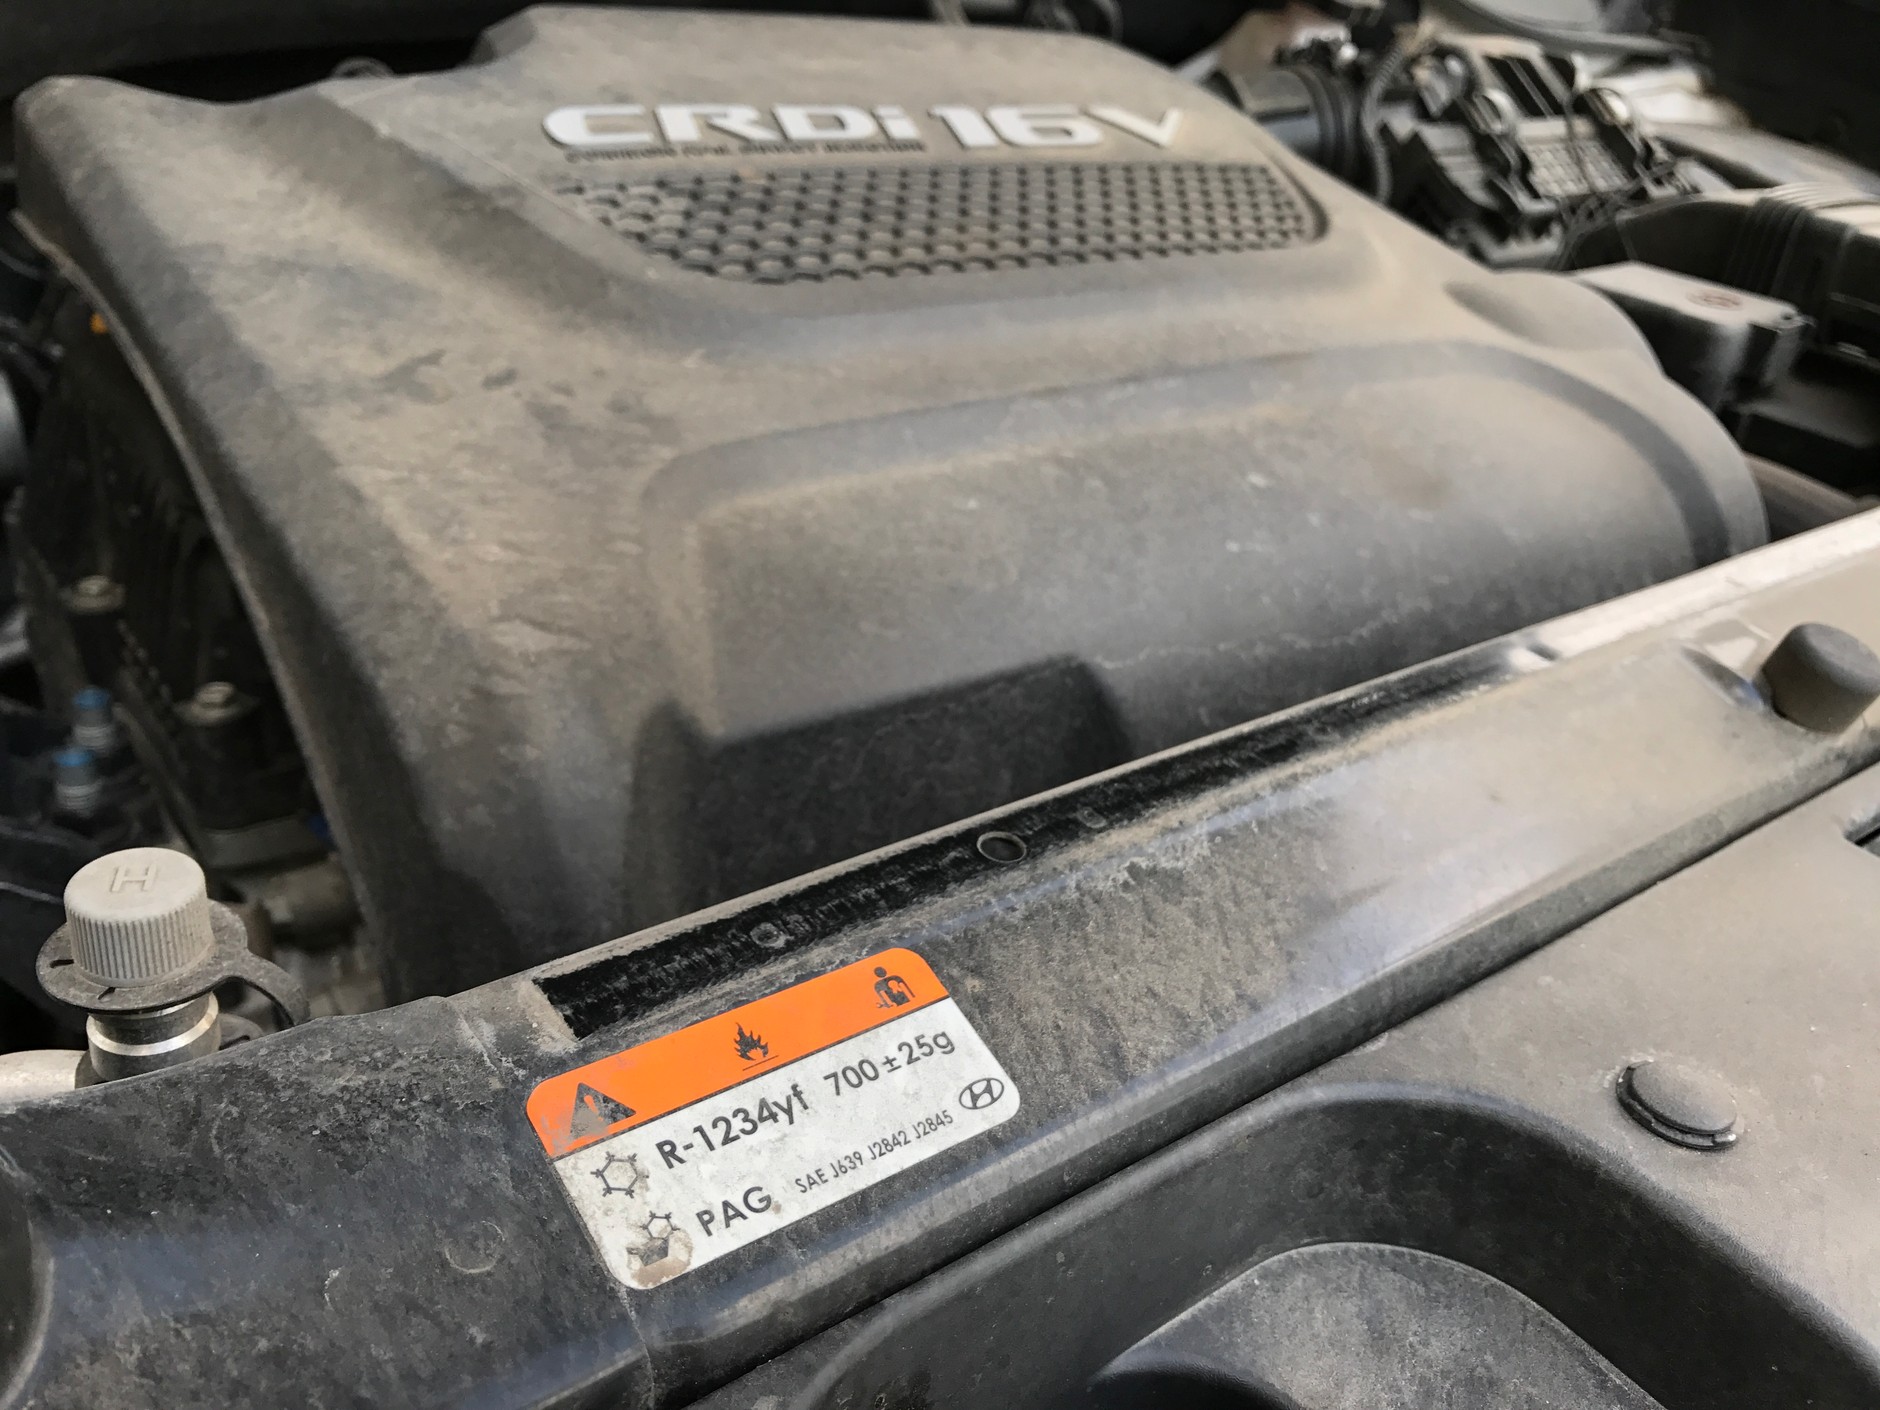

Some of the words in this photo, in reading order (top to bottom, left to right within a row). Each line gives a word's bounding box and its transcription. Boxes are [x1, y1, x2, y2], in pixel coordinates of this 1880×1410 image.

[542, 104, 922, 147] CRDi
[929, 105, 1186, 149] 16V
[110, 864, 160, 893] H
[656, 1083, 811, 1169] R-1234yf
[697, 1185, 773, 1237] PAG
[795, 1169, 829, 1196] SAE
[830, 1151, 864, 1179] J639
[868, 1130, 912, 1162] J2842
[914, 1109, 955, 1141] J2845
